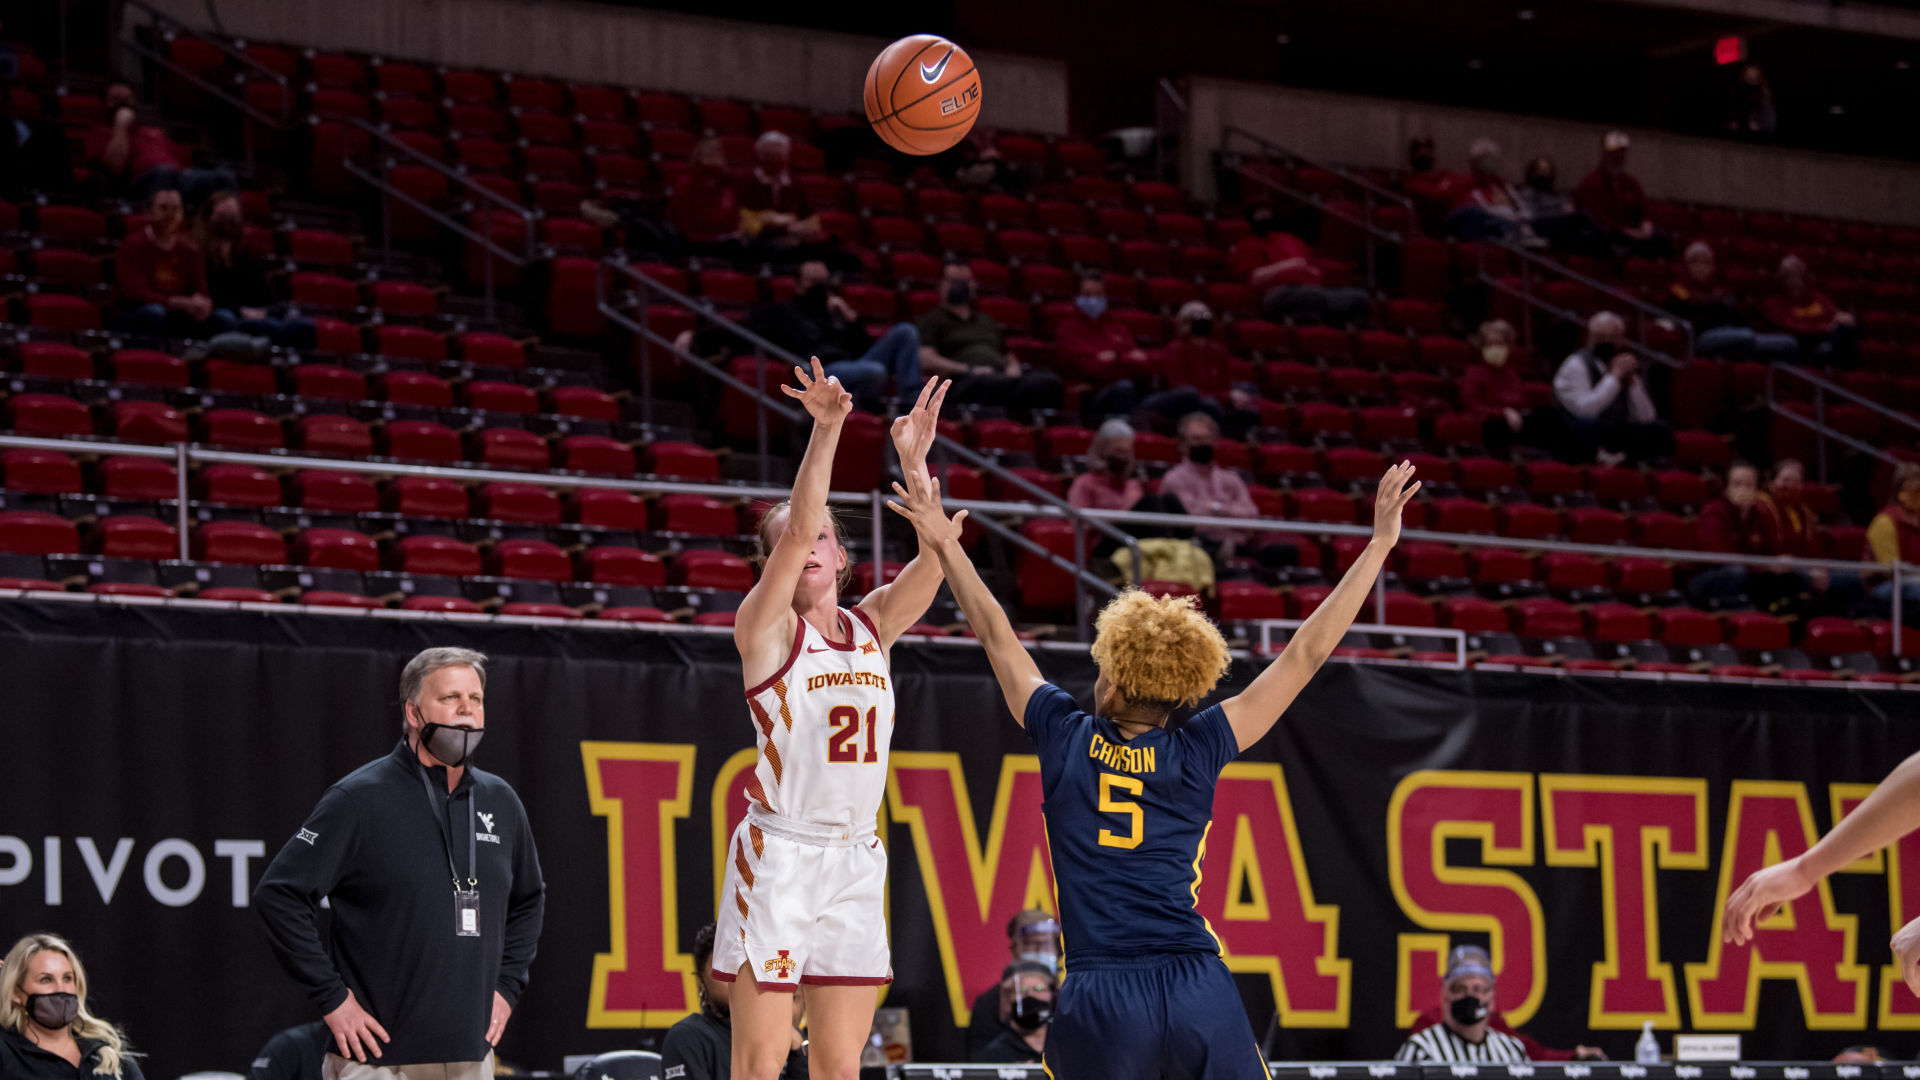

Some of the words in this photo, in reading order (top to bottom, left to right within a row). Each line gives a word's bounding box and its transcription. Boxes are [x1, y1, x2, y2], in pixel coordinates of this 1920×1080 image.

[940, 82, 979, 115] ELITE
[807, 672, 853, 693] IOWA
[828, 705, 878, 763] 21
[1089, 733, 1156, 773] CARSON
[1098, 772, 1144, 850] 5
